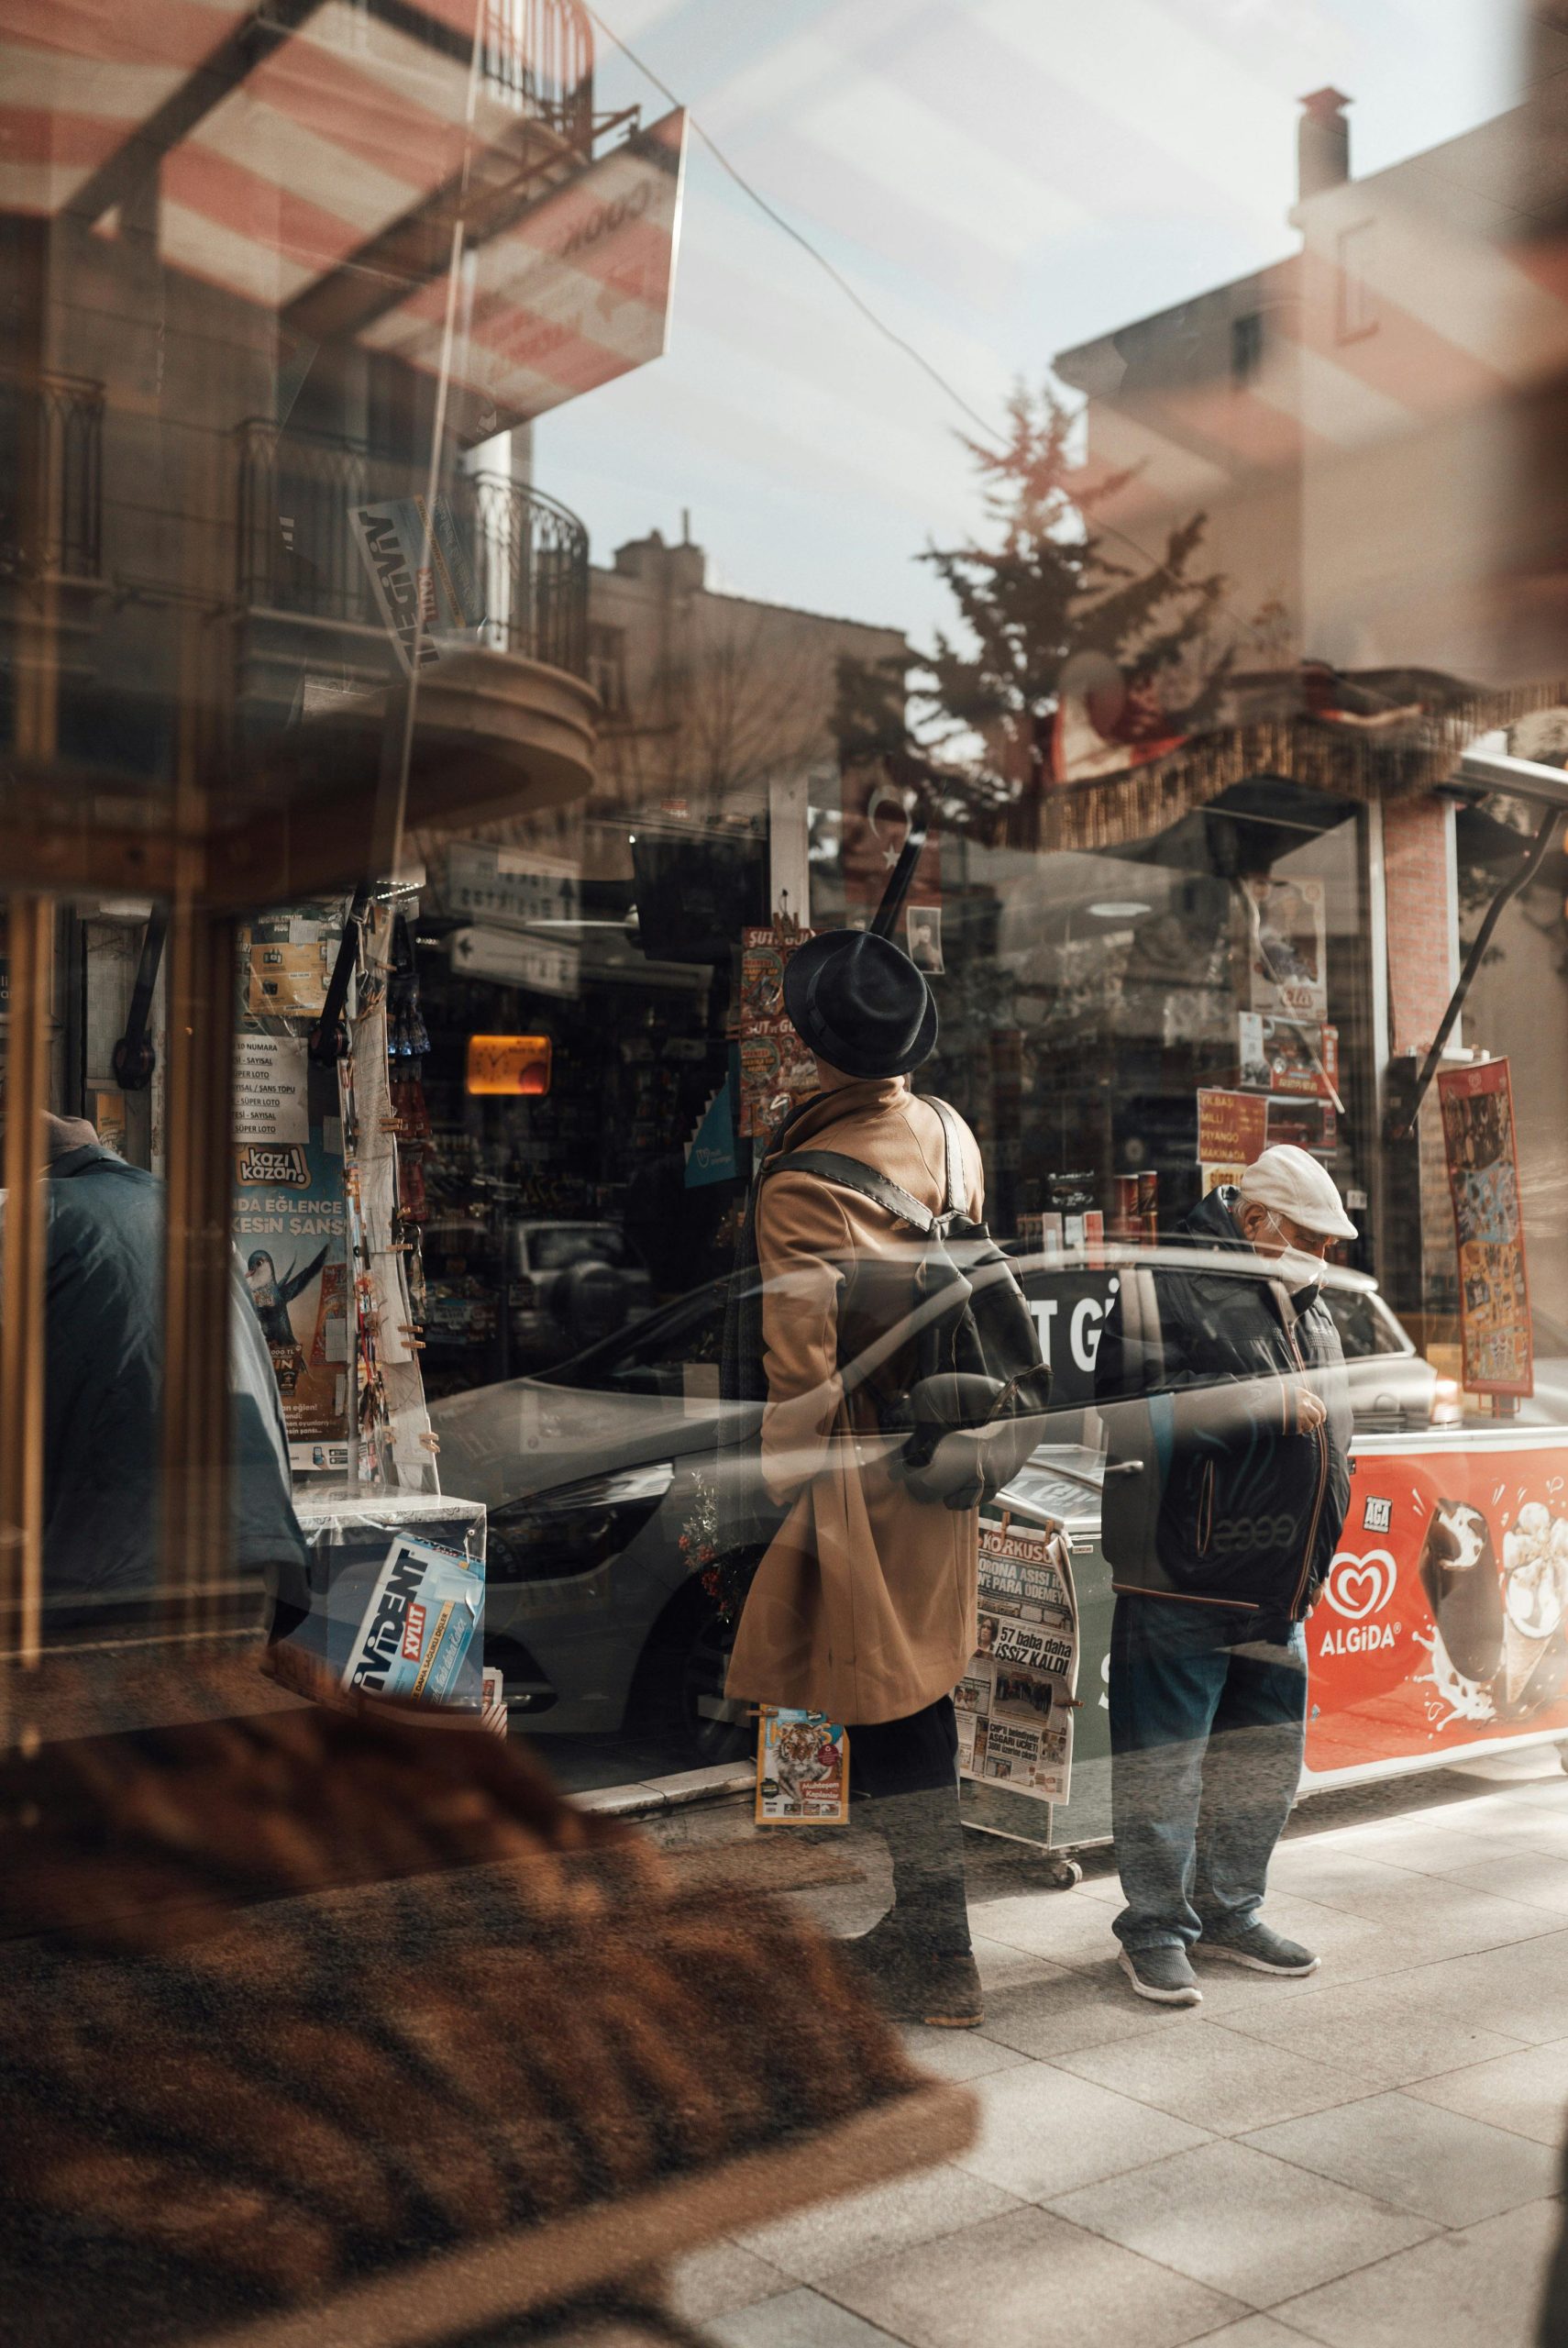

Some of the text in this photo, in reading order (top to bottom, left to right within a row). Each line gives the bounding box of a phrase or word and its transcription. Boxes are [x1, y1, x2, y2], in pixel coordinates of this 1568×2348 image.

[247, 1044, 278, 1052] NUMARA
[247, 1057, 273, 1065] SAYISAL
[240, 1097, 261, 1105] SÜPER
[235, 1124, 257, 1133] SÜPER
[249, 1148, 289, 1167] kazı
[265, 1195, 342, 1214] EĞLENCE
[978, 1557, 1018, 1579] ORONA
[992, 1576, 1022, 1595] PARA
[403, 1605, 424, 1657] XYLIT
[1000, 1626, 1072, 1658] 57 baba daha
[1029, 1651, 1070, 1676] KALDI
[415, 1669, 427, 1692] DAHA
